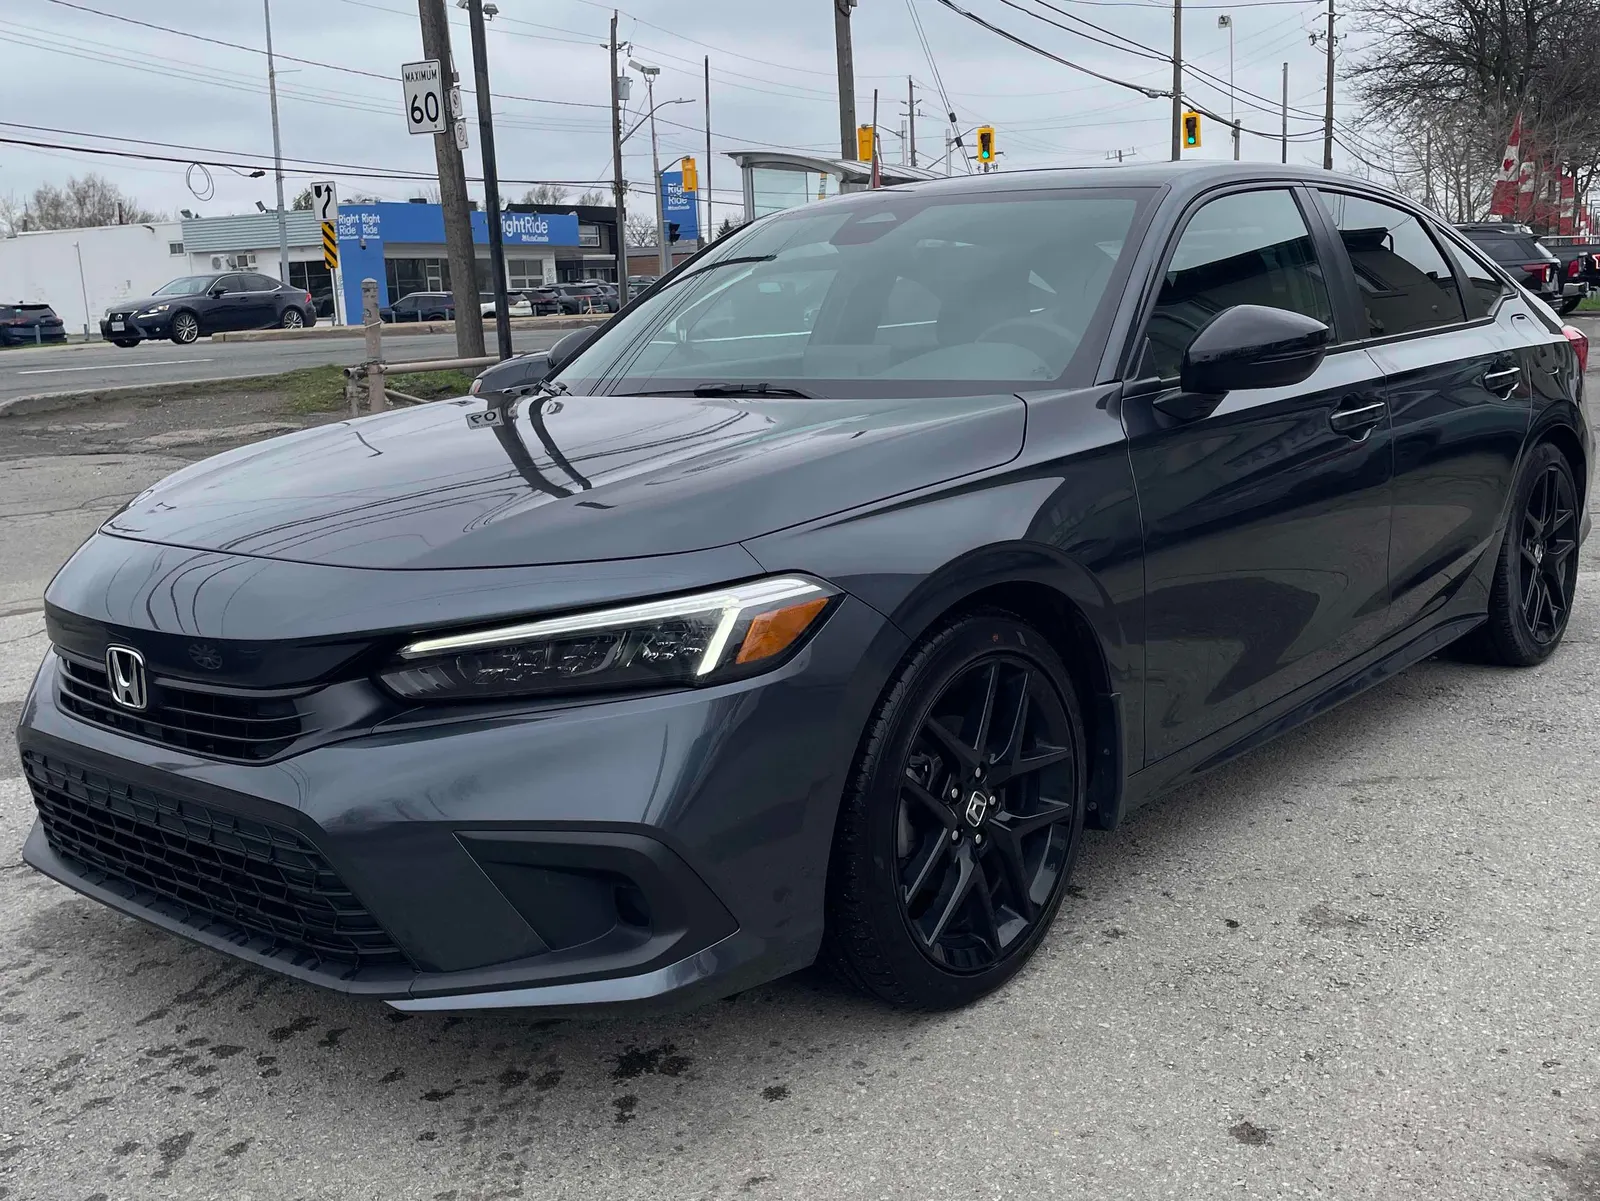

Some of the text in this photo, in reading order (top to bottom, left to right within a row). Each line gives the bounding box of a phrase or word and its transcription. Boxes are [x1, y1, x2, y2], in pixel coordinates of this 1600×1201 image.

[405, 69, 438, 83] MAXIMUM
[411, 91, 439, 124] 60
[667, 183, 684, 195] Rig
[338, 213, 360, 226] Right
[361, 213, 381, 225] Right
[339, 225, 357, 235] Ride
[362, 224, 378, 234] Ride
[500, 215, 548, 237] ightRide
